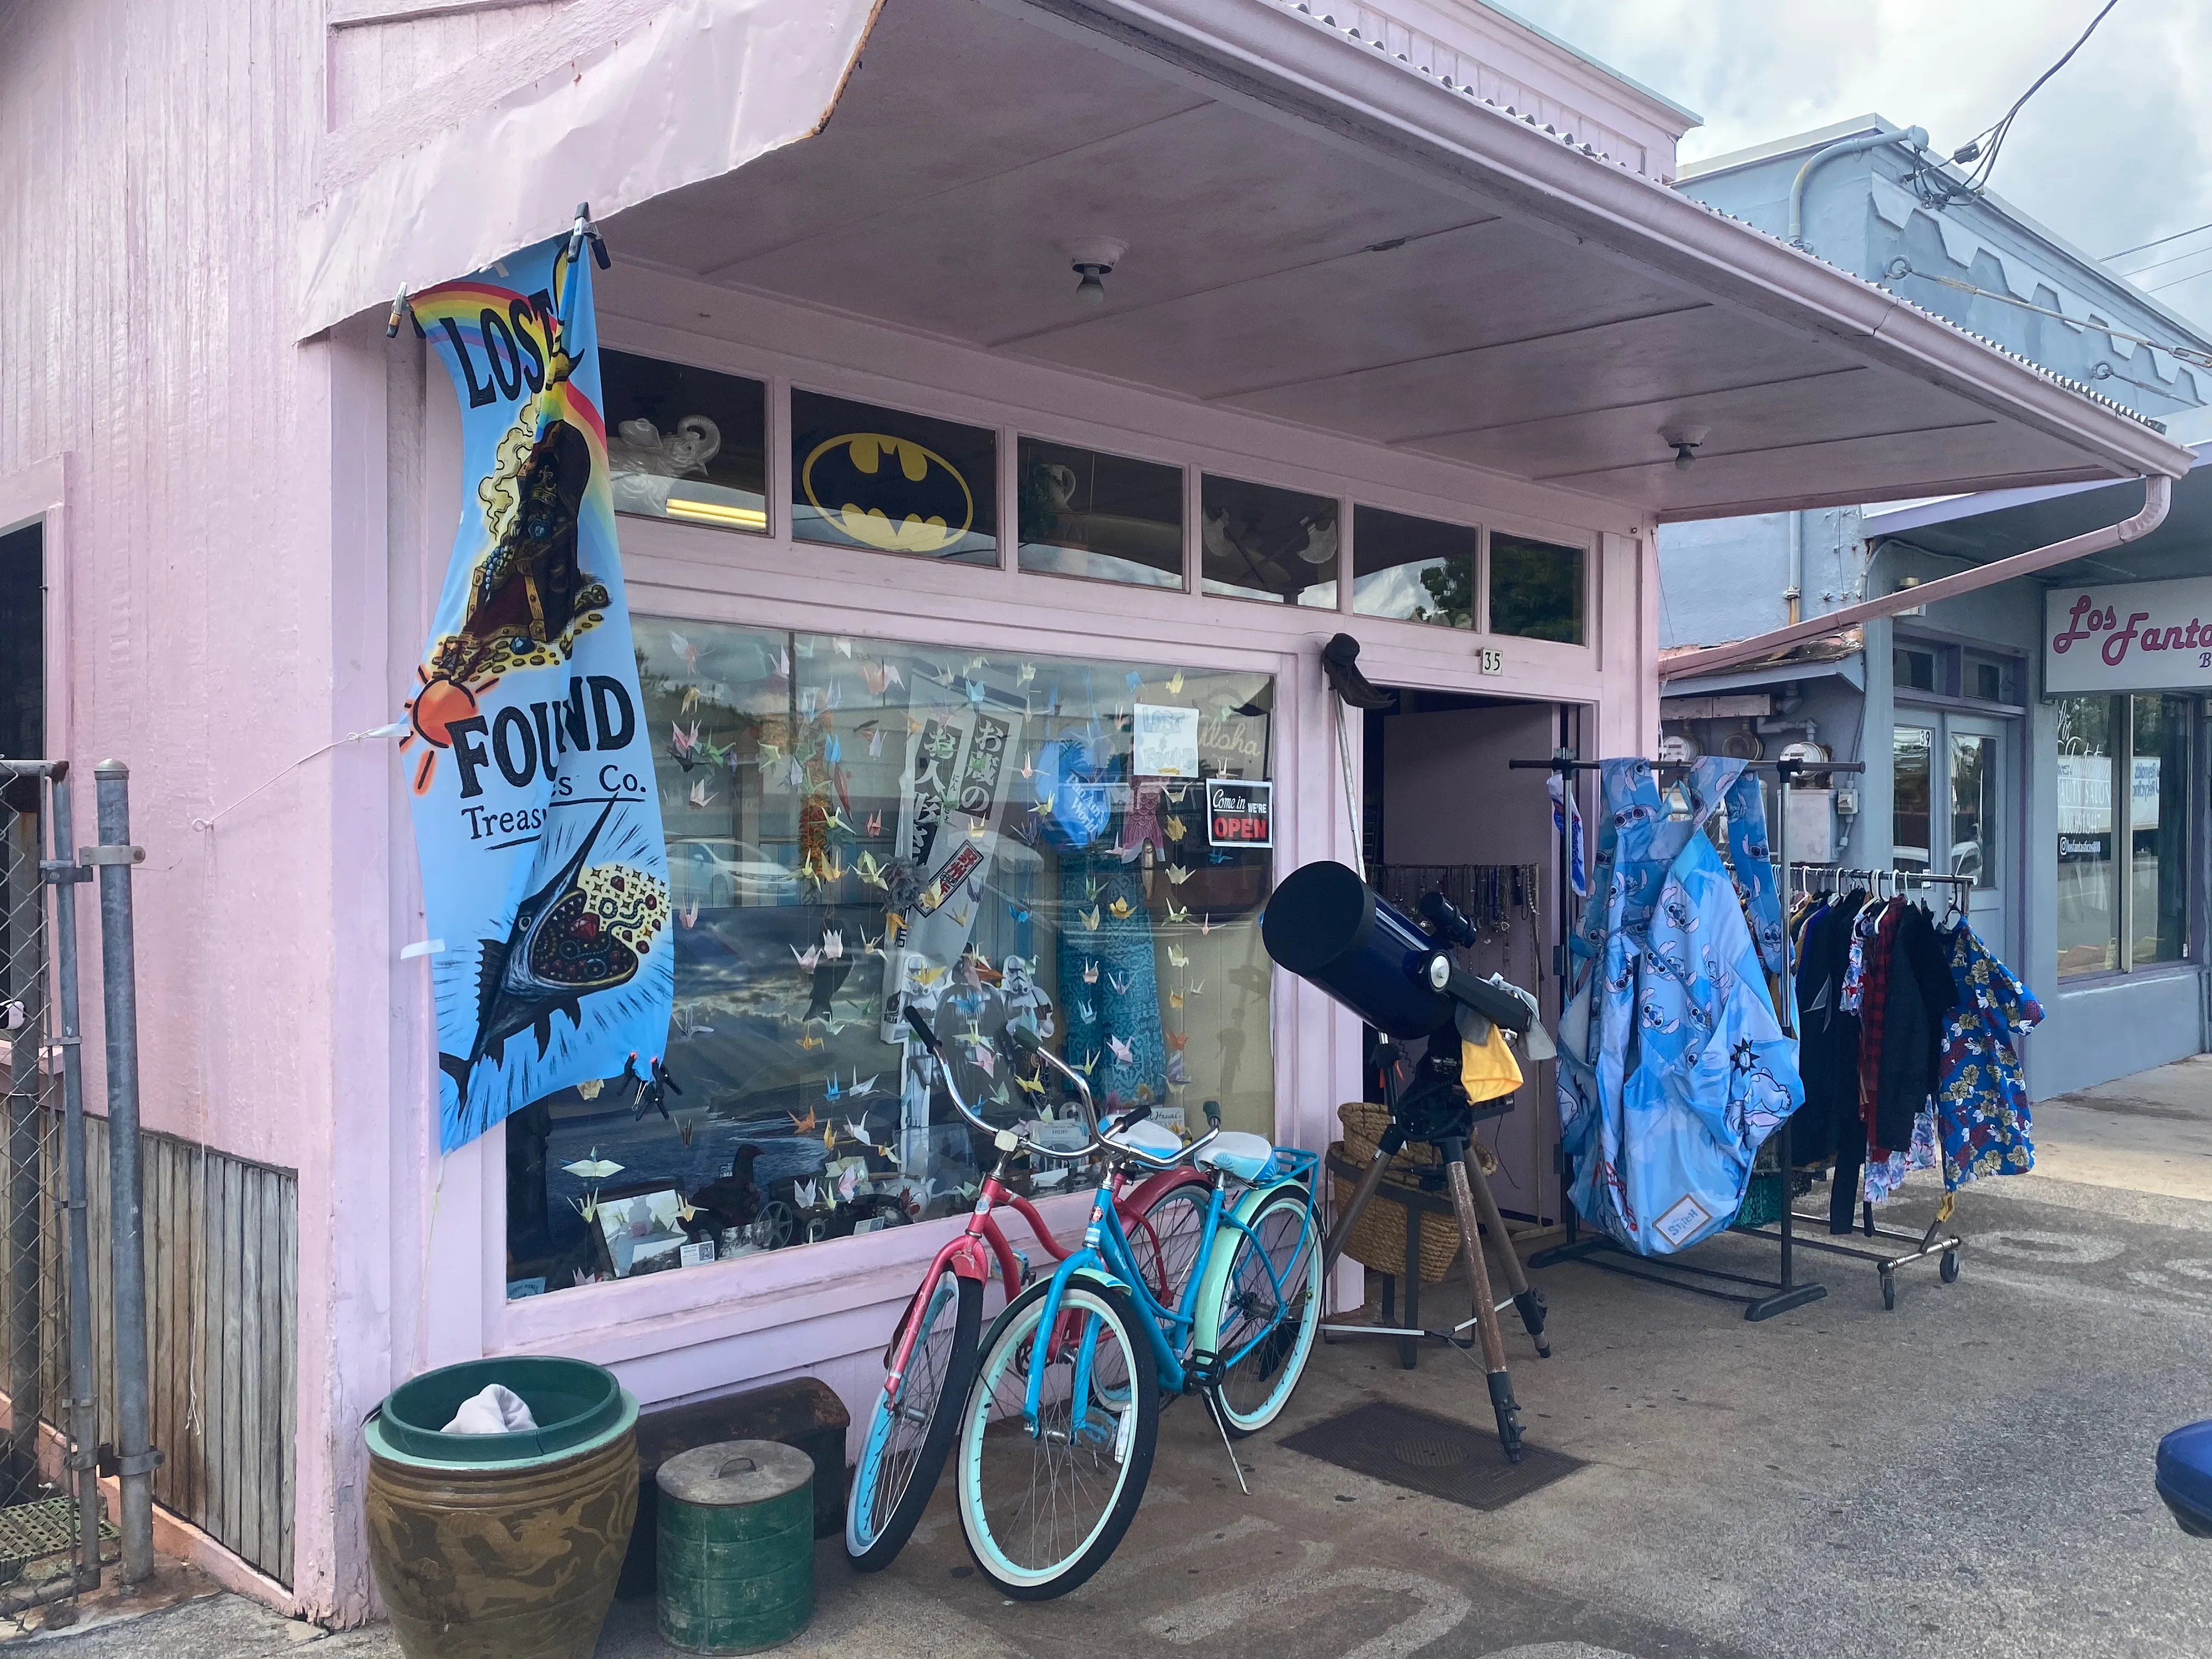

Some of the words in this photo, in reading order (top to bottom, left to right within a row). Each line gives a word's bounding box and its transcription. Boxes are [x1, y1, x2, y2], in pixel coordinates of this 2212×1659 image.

[439, 288, 554, 409] LOST
[2053, 595, 2117, 654] Los
[1484, 651, 1500, 671] 35
[1142, 706, 1185, 736] LOST
[444, 675, 635, 799] FOUND
[1921, 730, 1930, 746] 39
[1143, 747, 1198, 770] FOUND
[599, 764, 646, 792] Co.
[1070, 797, 1098, 833] World
[1212, 788, 1236, 809] Come
[1237, 795, 1246, 810] in
[1248, 803, 1267, 814] WE'RE
[1214, 817, 1267, 838] OPEN
